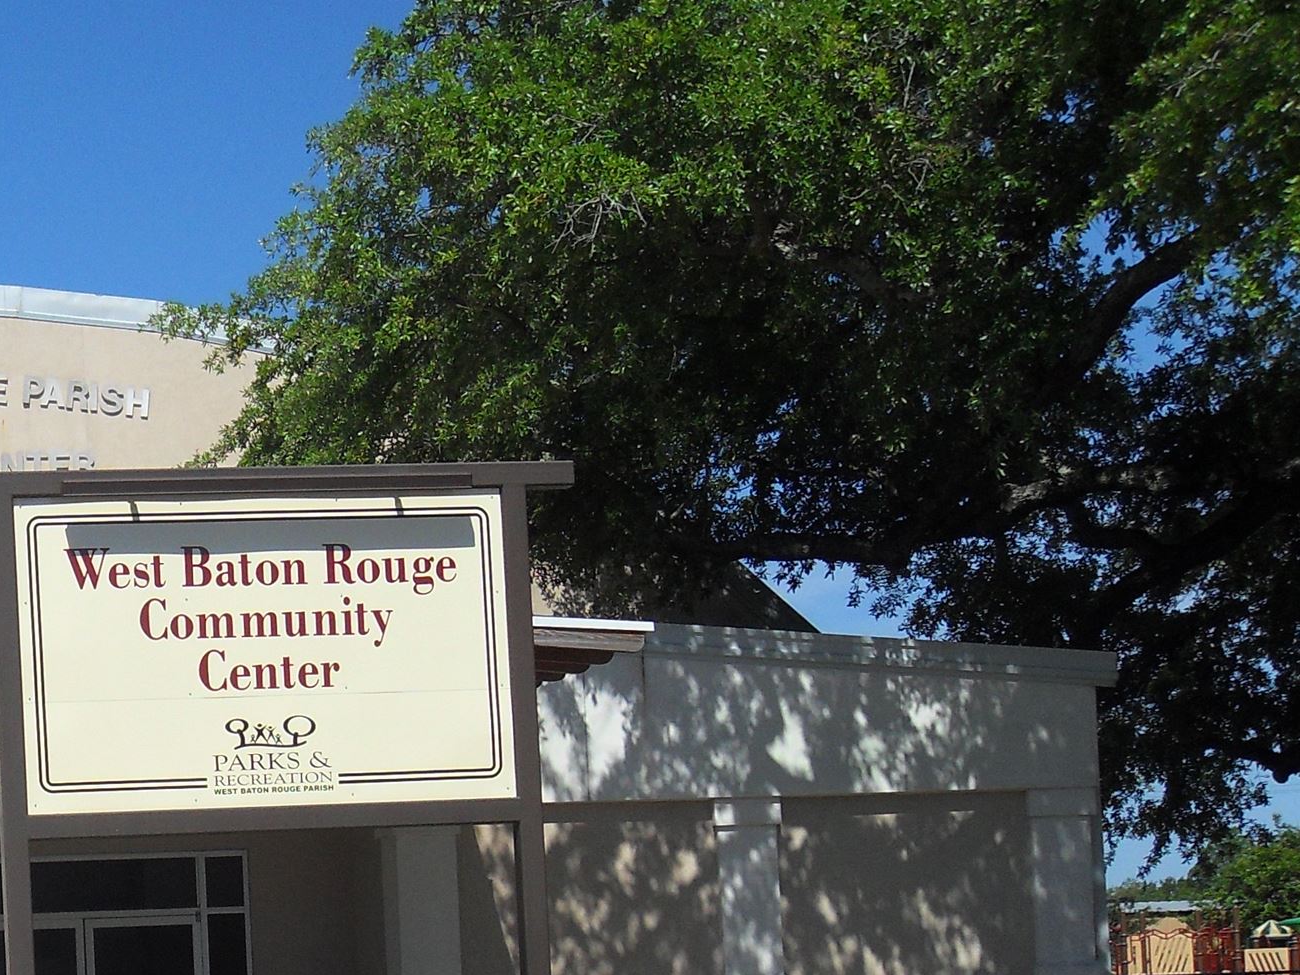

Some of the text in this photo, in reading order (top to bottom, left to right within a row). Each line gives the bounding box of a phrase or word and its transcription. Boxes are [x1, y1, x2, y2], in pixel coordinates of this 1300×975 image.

[22, 375, 151, 420] PARISH
[64, 543, 457, 595] West Baton Rouge
[139, 597, 394, 647] Community
[198, 649, 340, 692] Center
[212, 751, 332, 772] PARKS &
[214, 771, 333, 787] RECREATION
[240, 787, 270, 795] BATON
[303, 784, 334, 792] PARISH
